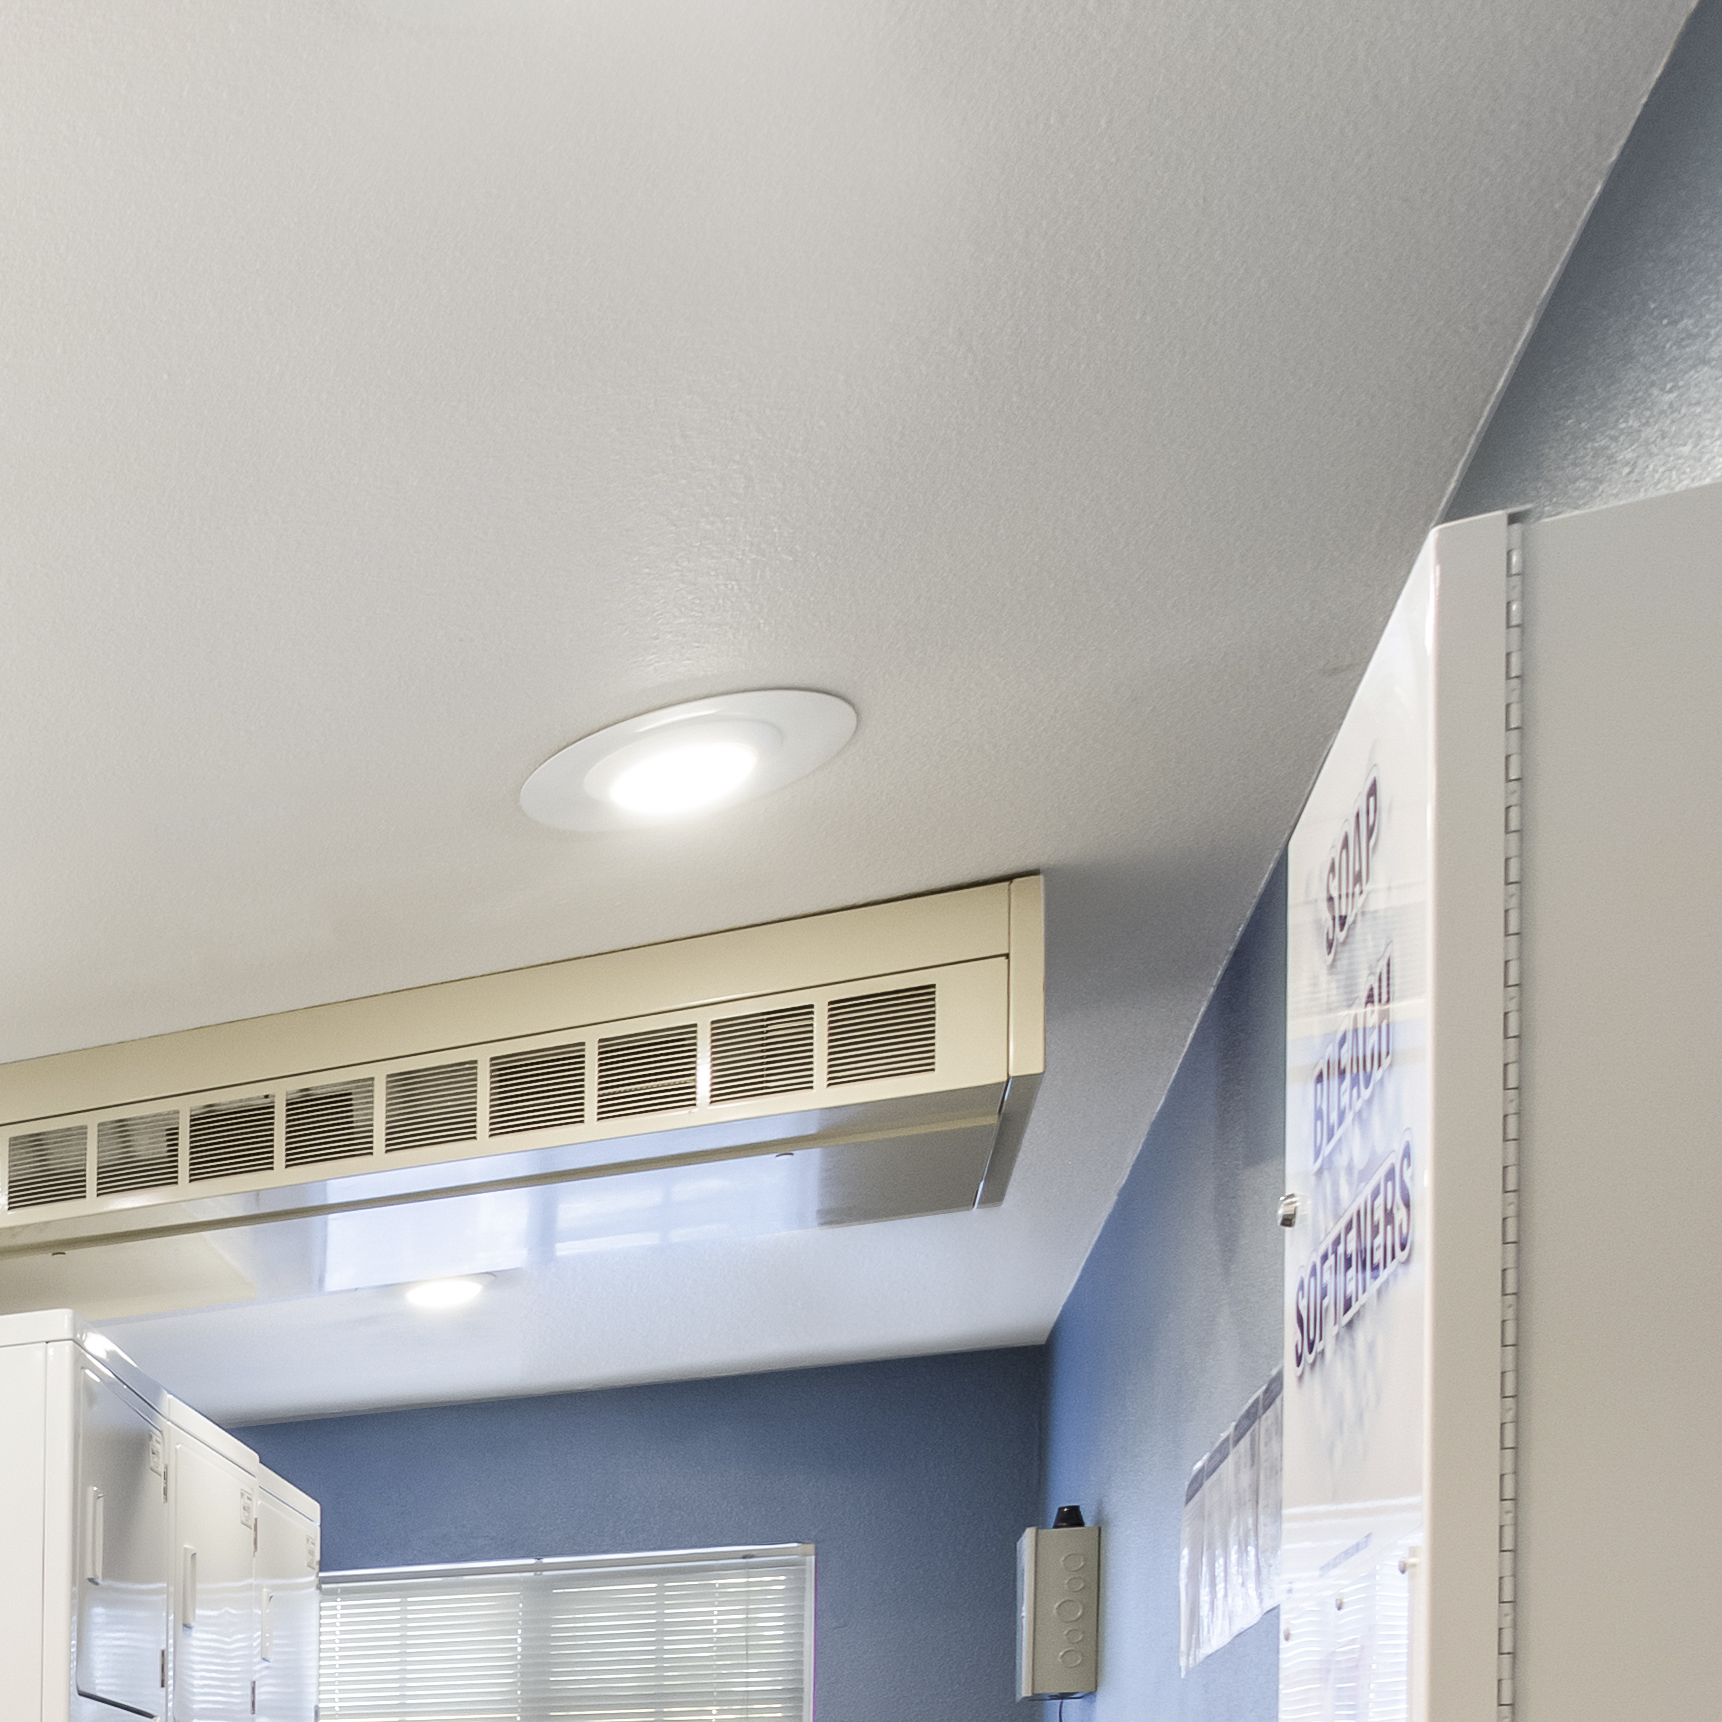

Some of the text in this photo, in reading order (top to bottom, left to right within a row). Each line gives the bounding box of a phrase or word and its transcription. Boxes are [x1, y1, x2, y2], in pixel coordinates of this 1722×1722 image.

[1324, 771, 1380, 958] SOAP
[1311, 944, 1394, 1169] BLEACH
[1294, 1131, 1414, 1375] SOFTENERS
